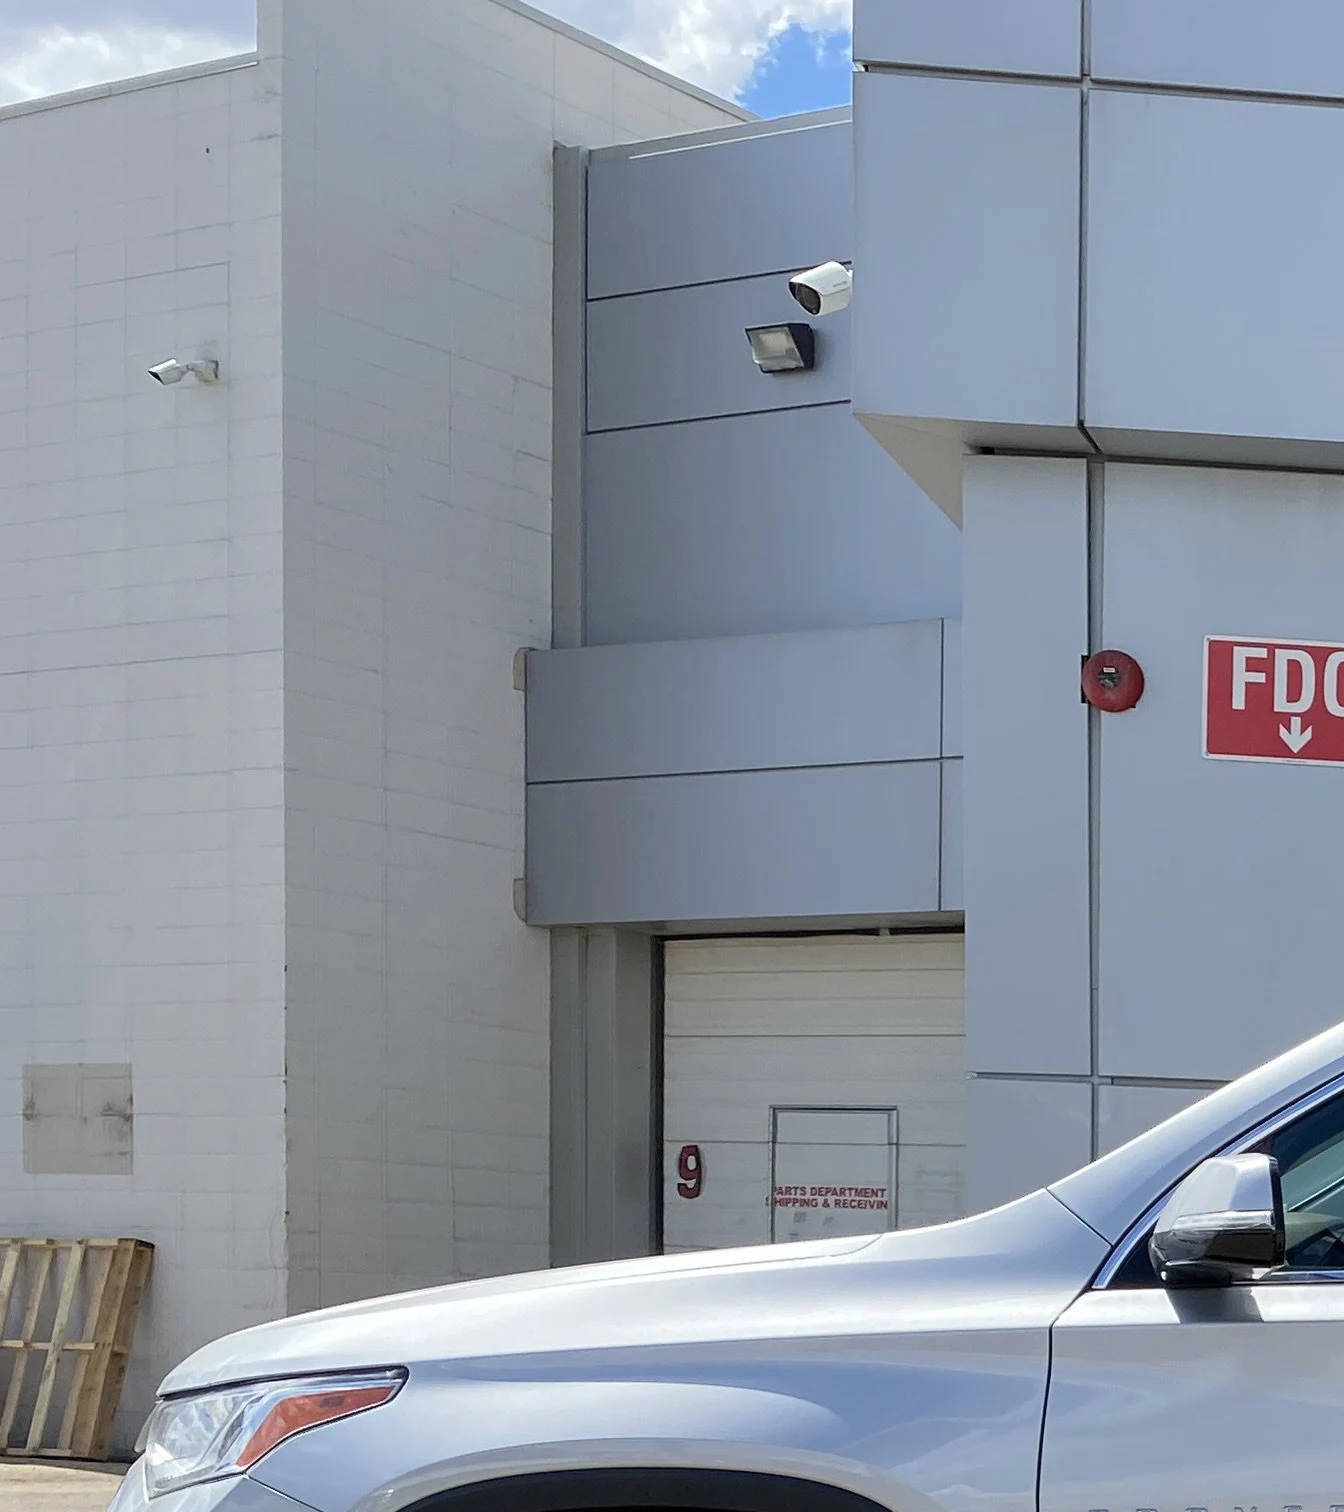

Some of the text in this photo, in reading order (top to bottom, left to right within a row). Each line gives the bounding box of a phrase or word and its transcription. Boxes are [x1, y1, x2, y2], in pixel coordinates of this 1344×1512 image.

[677, 1144, 702, 1199] 9
[810, 1186, 887, 1198] DEPARTMENT
[822, 1199, 830, 1208] &
